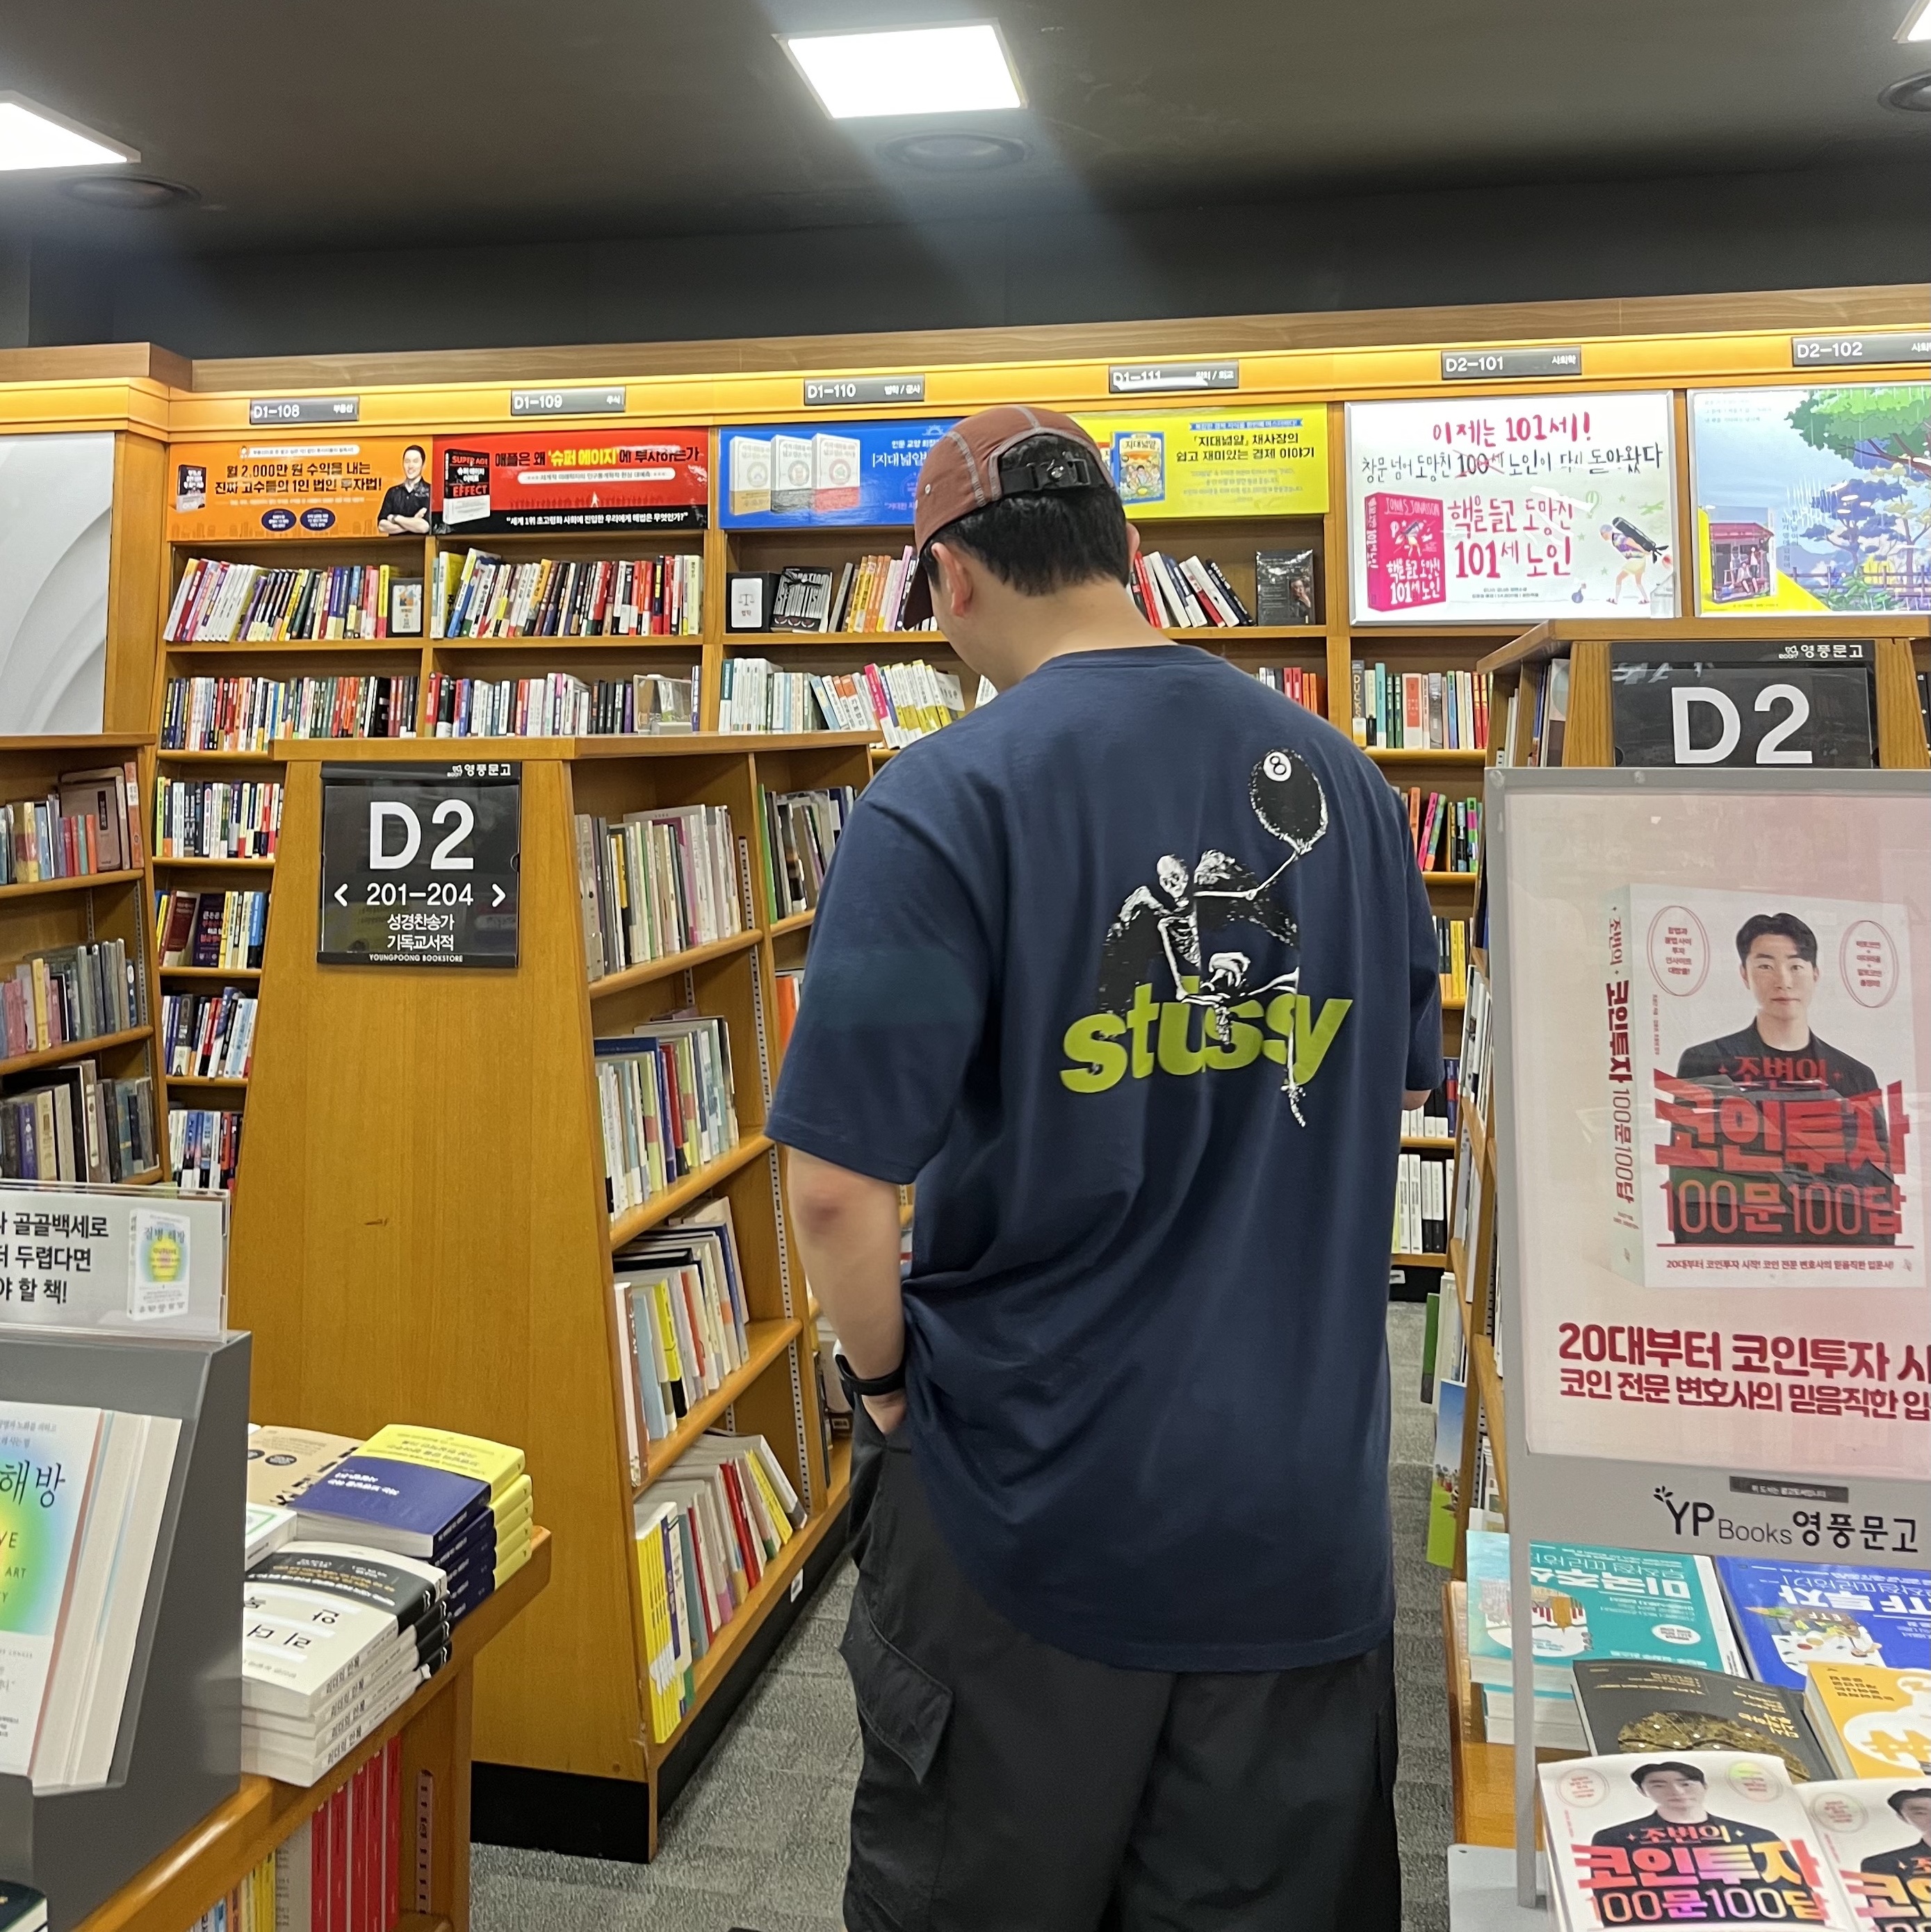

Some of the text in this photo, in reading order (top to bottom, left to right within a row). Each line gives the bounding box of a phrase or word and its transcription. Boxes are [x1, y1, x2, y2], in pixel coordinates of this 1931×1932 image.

[1551, 354, 1576, 366] 사회학
[1797, 341, 1863, 359] D2-102
[1445, 356, 1504, 373] D2-101
[1113, 370, 1161, 384] D1-111
[514, 393, 563, 410] D1-109
[807, 384, 856, 400] D1-110
[253, 404, 300, 419] D1-108
[1251, 432, 1298, 445] 채사장의
[1433, 411, 1591, 447] 이제는 101세!
[494, 451, 531, 467] 애플은
[533, 450, 546, 466] 왜
[1203, 449, 1248, 461] 재미있는
[1279, 446, 1314, 459] 이야기
[241, 462, 288, 478] 2,000만
[307, 461, 343, 477] 수익을
[346, 461, 371, 475] 내는
[1362, 457, 1385, 484] 창문
[1390, 455, 1412, 480] 넘어
[1416, 452, 1451, 482] 도망친
[1457, 450, 1505, 477] 100세
[1508, 449, 1551, 476] 노인이
[215, 476, 382, 496] 진짜 고수들의 1인 법인 투자법!
[453, 484, 488, 498] EFFECT
[1384, 496, 1409, 516] JONAS
[605, 513, 632, 523] 우리에게
[1447, 495, 1574, 539] 핵을 들고 도망친
[1455, 535, 1572, 578] 101세 노인
[1421, 576, 1441, 600] 노인
[1800, 644, 1864, 659] 영풍문고
[1353, 674, 1362, 718] DUCKS
[1671, 682, 1814, 764] D2
[464, 763, 511, 777] 영풍문고
[1269, 755, 1287, 776] 8
[369, 799, 475, 870] D2
[366, 882, 474, 906] 201-204
[387, 913, 455, 931] 성경찬송가
[387, 934, 454, 951] 기독교서적
[1608, 915, 1624, 967] 조변의
[369, 953, 463, 963] YOUNGPOONG BOOKSTORE
[1606, 979, 1633, 1083] 코인투자
[1732, 1055, 1829, 1094] 조변의
[1653, 1067, 1910, 1174] 코인투자
[1659, 1179, 1907, 1236] 100문100답
[13, 1211, 109, 1239] 골골백세로
[15, 1245, 92, 1272] 두렵다면
[1666, 1259, 1704, 1270] 20대부터
[1706, 1259, 1740, 1270] 코인투자
[1763, 1260, 1780, 1270] 코인
[1782, 1260, 1798, 1270] 전문
[1800, 1260, 1832, 1270] 변호사의
[1834, 1260, 1866, 1270] 믿음직한
[0, 1277, 68, 1305] 야 할 책!
[1559, 1322, 1931, 1384] 20대부터 코인투자 시
[1560, 1367, 1931, 1422] 코인 전문 변호사의 믿음직한 입
[1792, 1509, 1919, 1554] 영풍문고
[1531, 1550, 1606, 1571] 따라하
[5, 1566, 27, 1580] ART
[1778, 1585, 1931, 1616] TF 투자
[1808, 1611, 1843, 1621] ETF
[1640, 1824, 1732, 1845] 조변의
[1570, 1838, 1823, 1890] 코인투자
[1909, 1856, 1931, 1874] 조
